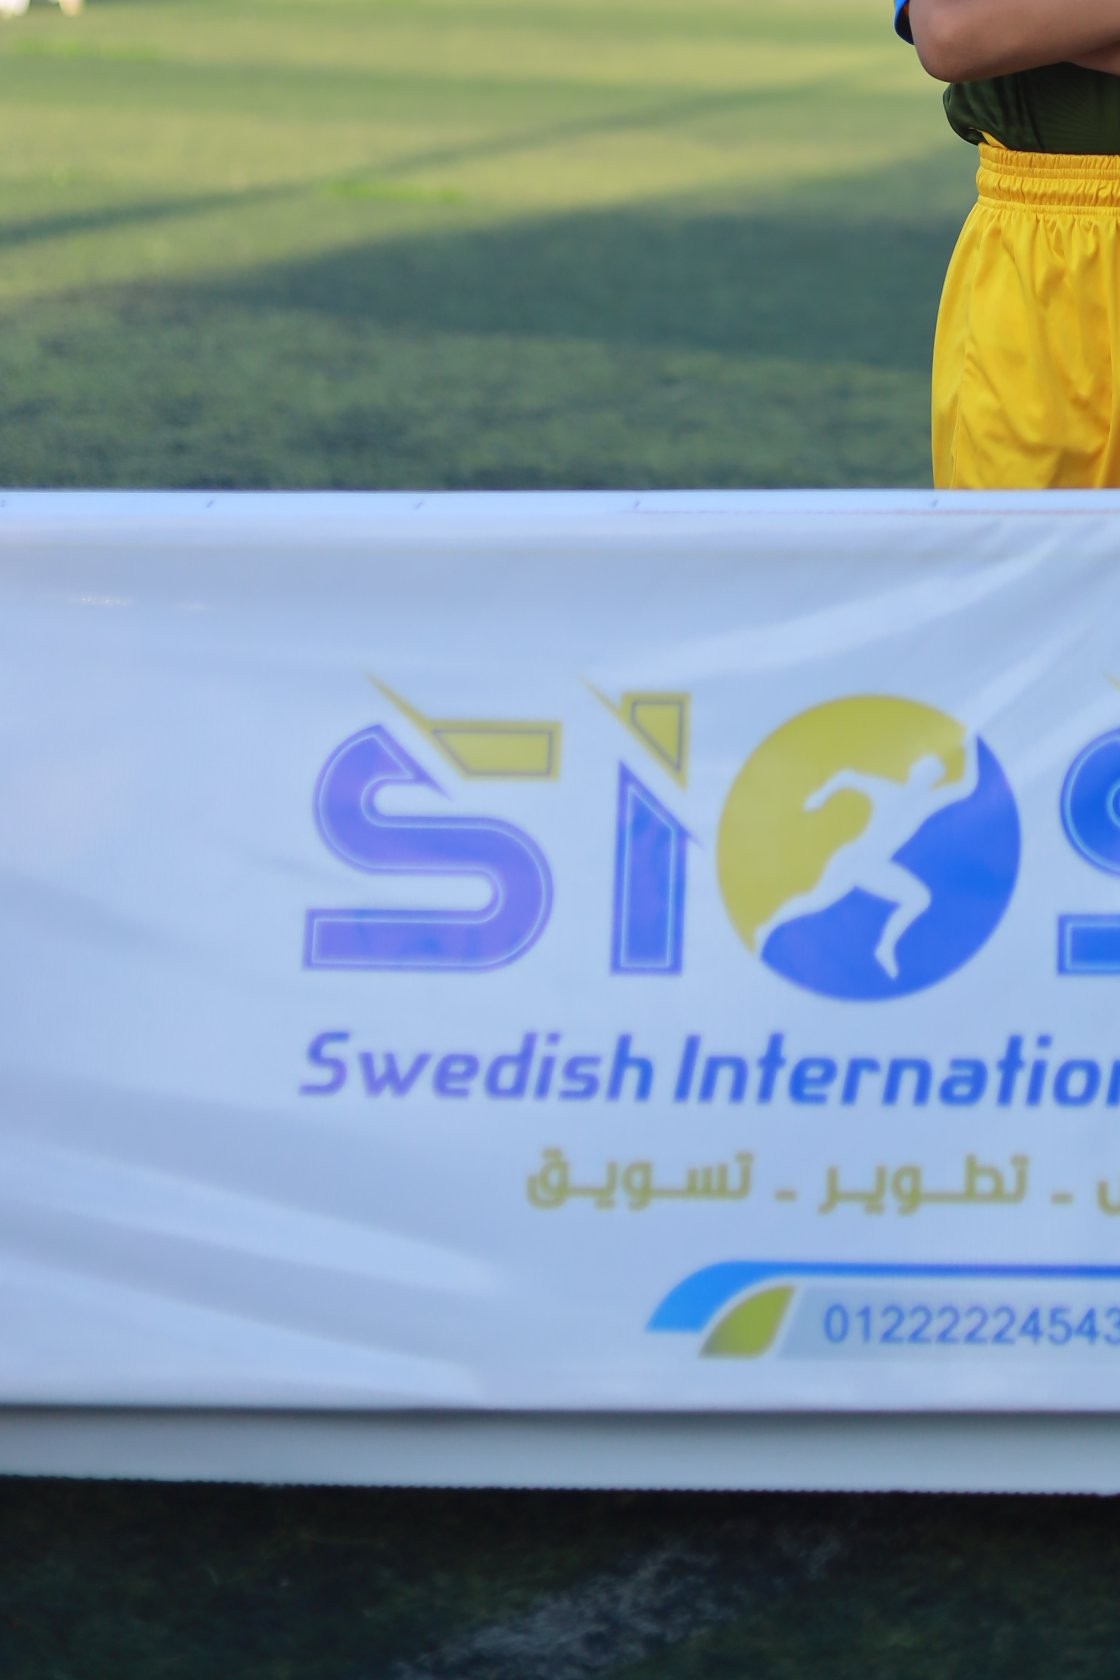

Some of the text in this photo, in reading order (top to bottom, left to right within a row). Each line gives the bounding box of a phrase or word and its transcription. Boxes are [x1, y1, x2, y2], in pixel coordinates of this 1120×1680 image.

[300, 1031, 653, 1102] Swedish
[525, 1146, 754, 1211] تسويق
[817, 1153, 1029, 1216] تطوير
